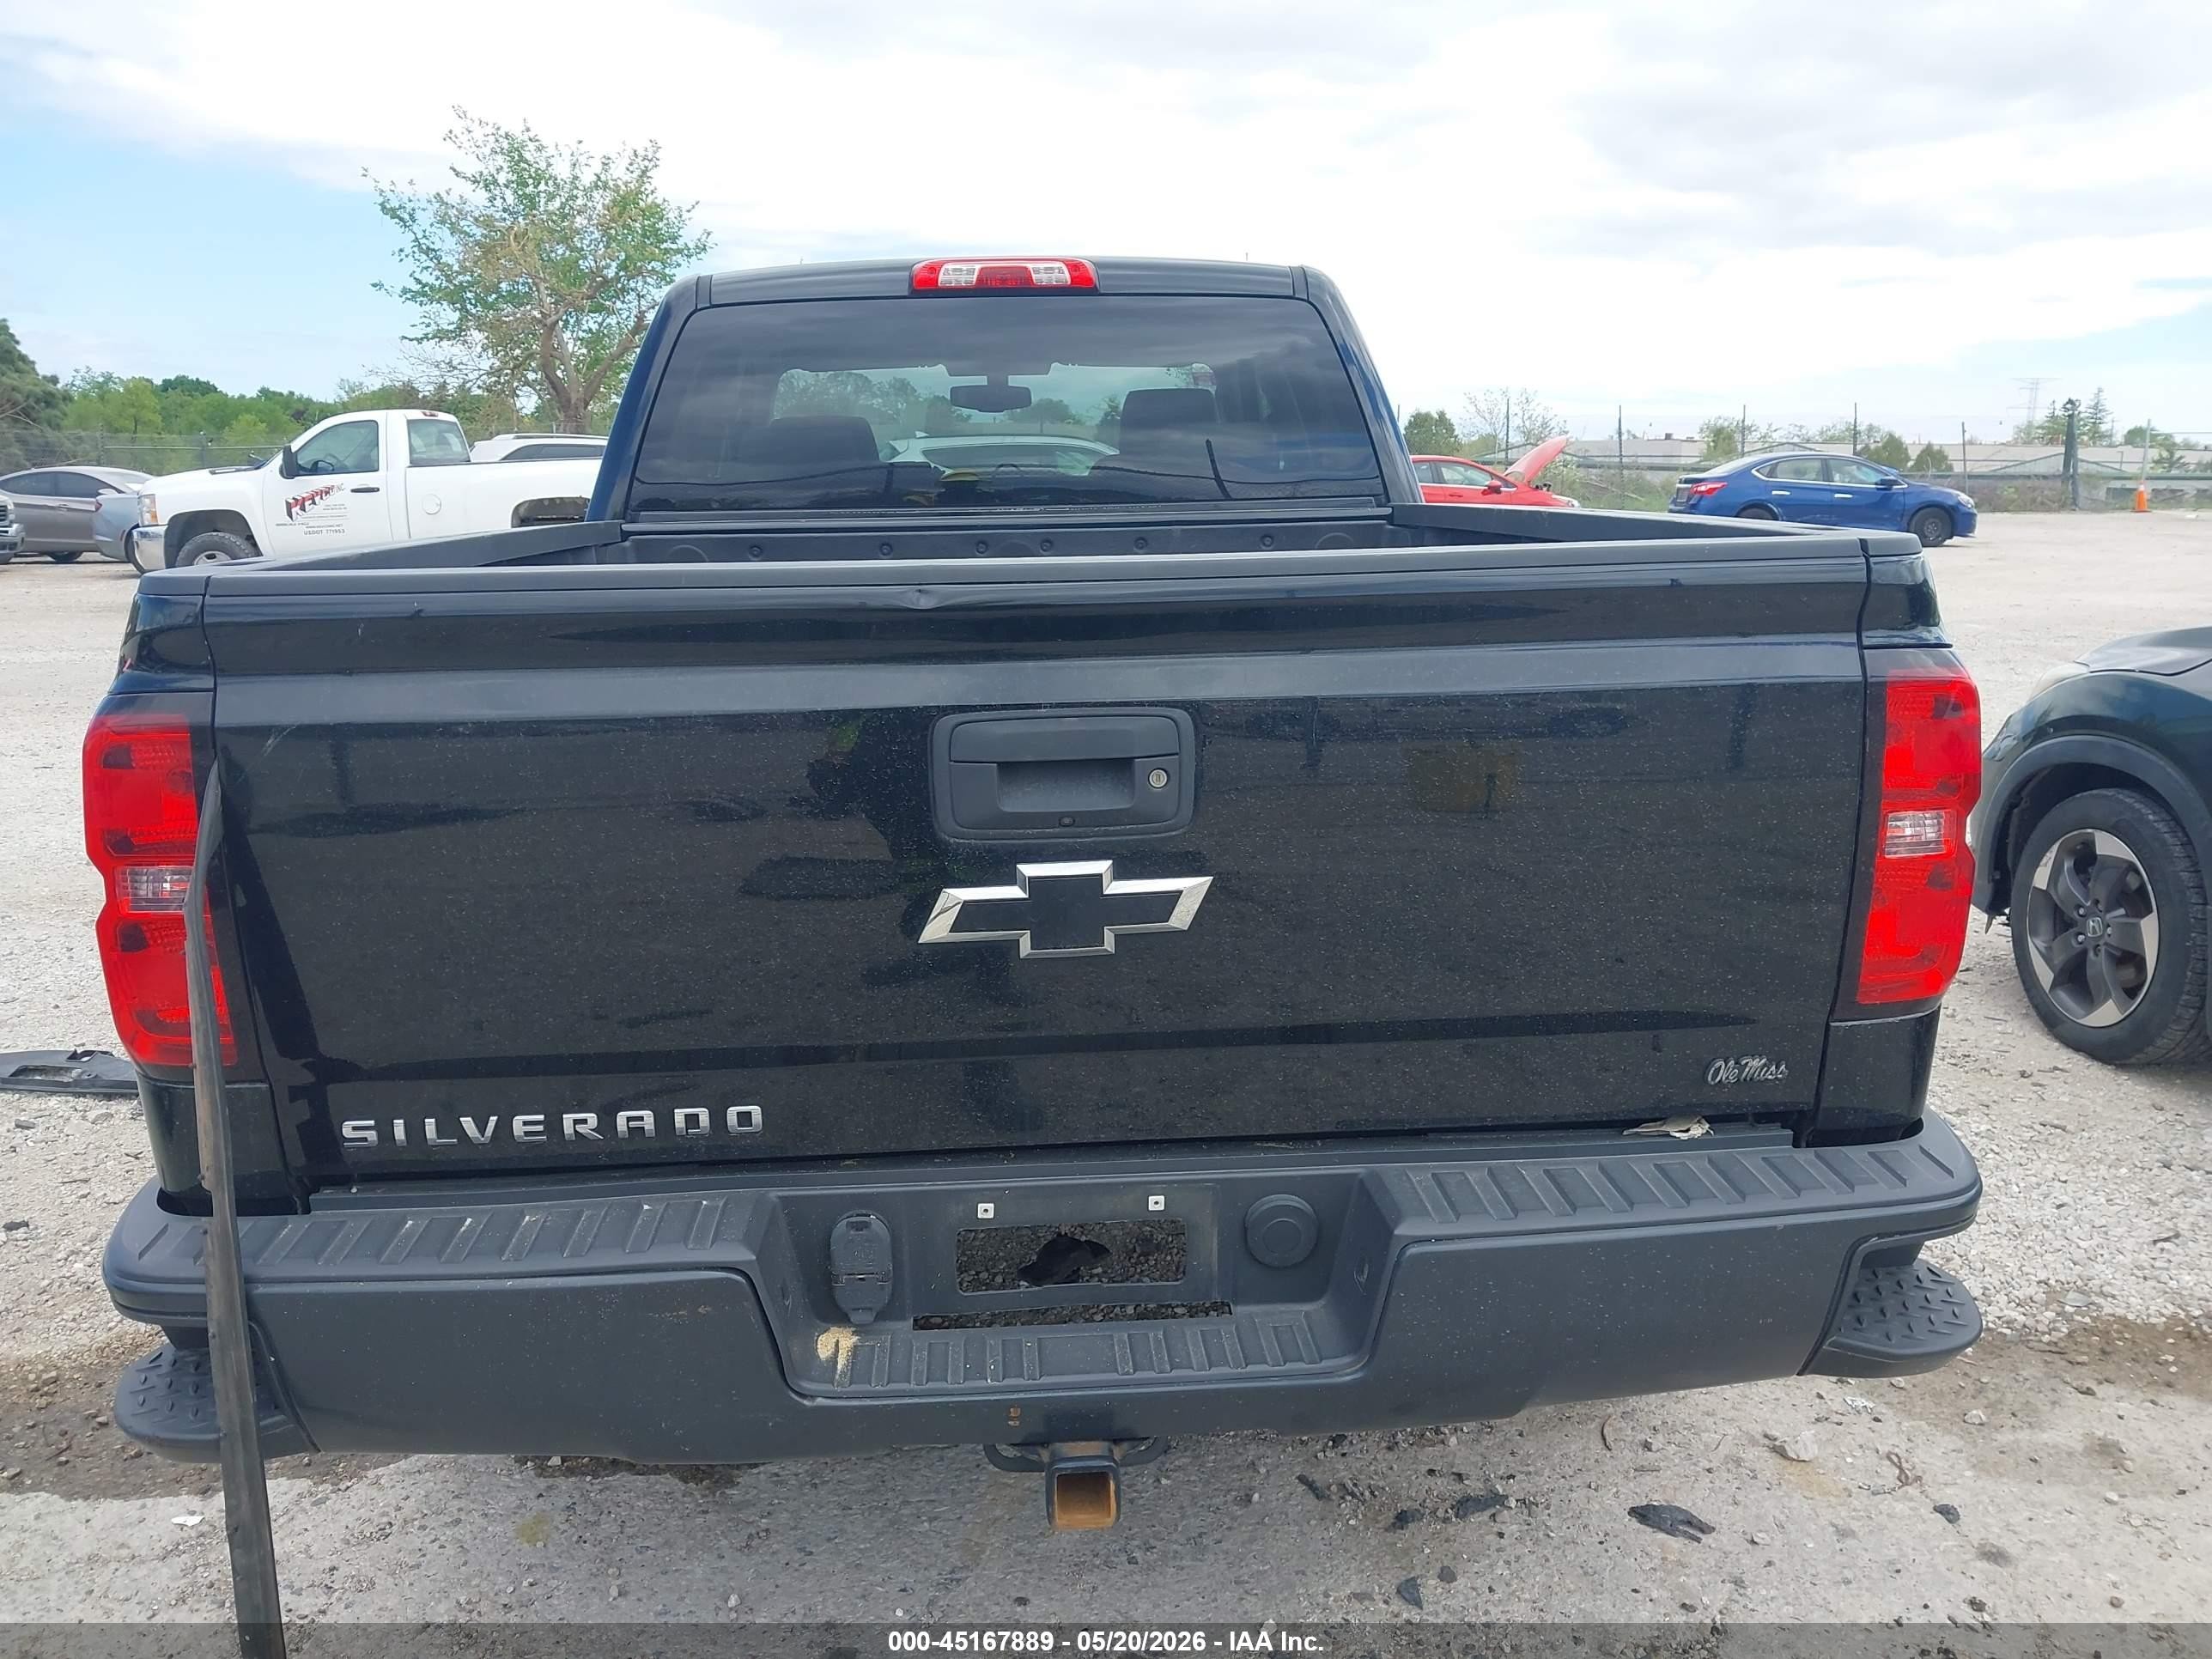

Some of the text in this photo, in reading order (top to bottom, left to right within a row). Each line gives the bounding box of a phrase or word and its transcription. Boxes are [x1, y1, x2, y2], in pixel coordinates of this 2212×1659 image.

[1705, 1055, 1788, 1085] Ole Miss
[342, 1104, 763, 1147] SILVERADO
